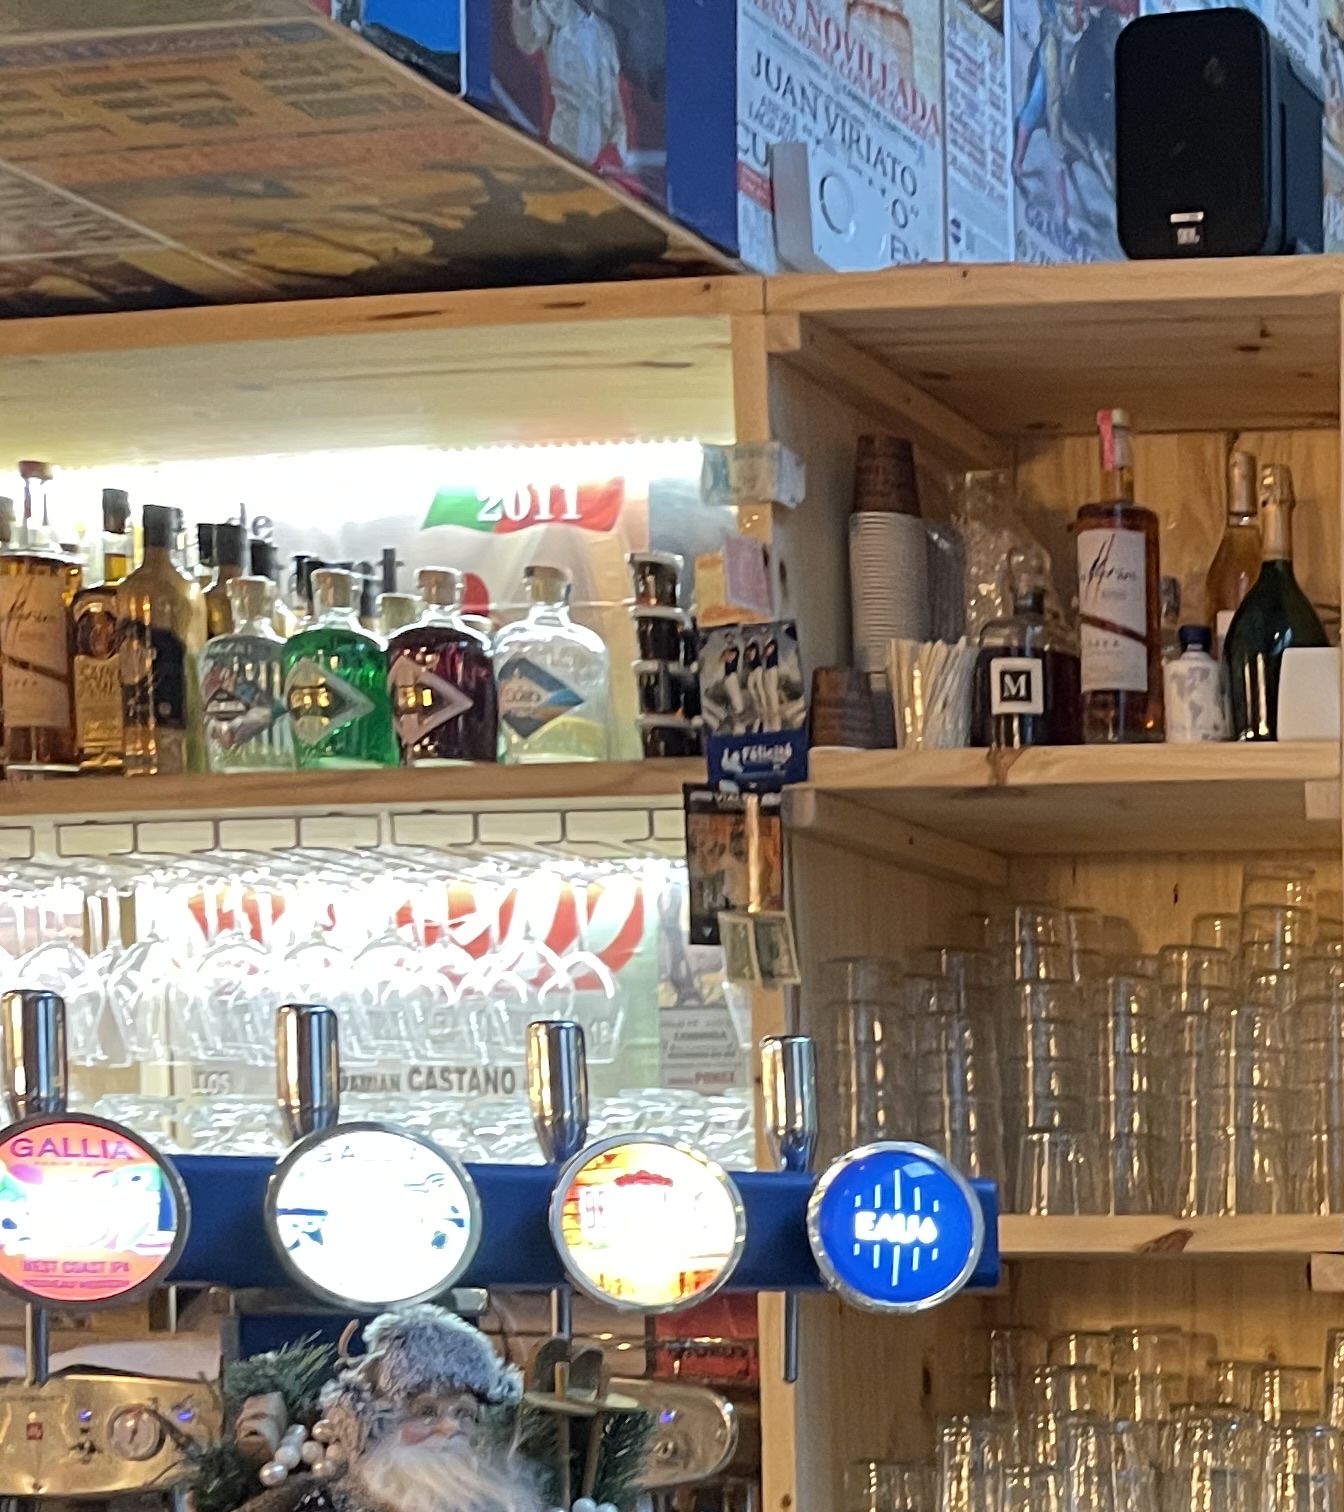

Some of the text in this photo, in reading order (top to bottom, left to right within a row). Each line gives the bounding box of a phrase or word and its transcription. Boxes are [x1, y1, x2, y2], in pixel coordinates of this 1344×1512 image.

[752, 50, 819, 123] JUAN
[823, 101, 918, 198] VIRIATO
[477, 485, 583, 522] 2011
[1003, 669, 1030, 703] M
[10, 1136, 134, 1162] GALLIA
